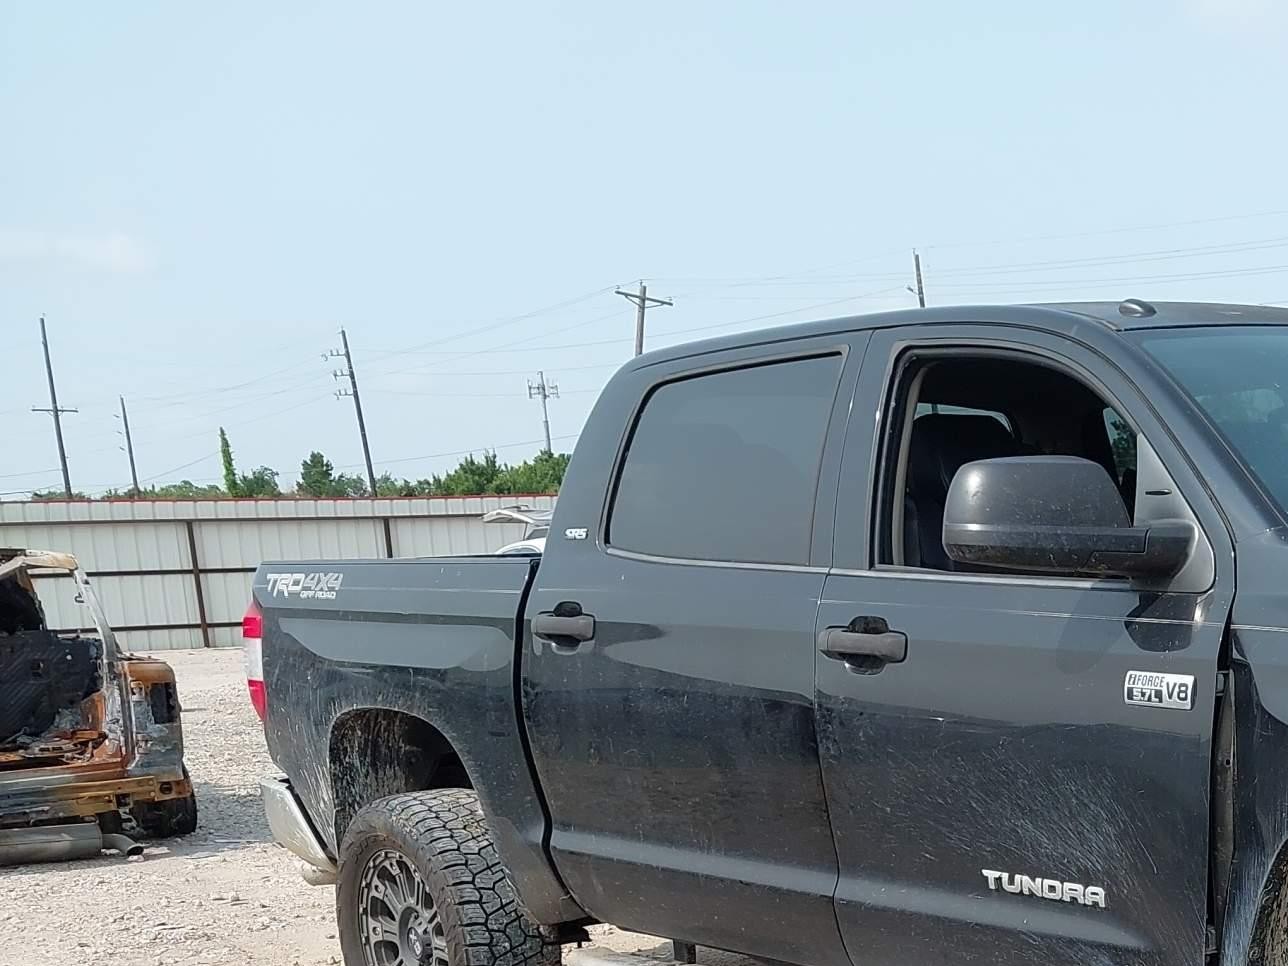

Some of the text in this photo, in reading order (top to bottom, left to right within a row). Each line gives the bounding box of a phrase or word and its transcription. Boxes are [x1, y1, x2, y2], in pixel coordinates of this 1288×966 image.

[564, 528, 588, 540] SR5
[266, 573, 305, 599] TRD
[300, 590, 337, 601] OFF ROAD
[1132, 688, 1161, 703] 5.7L
[1166, 681, 1189, 702] V8
[981, 869, 1106, 908] TUNDRA
